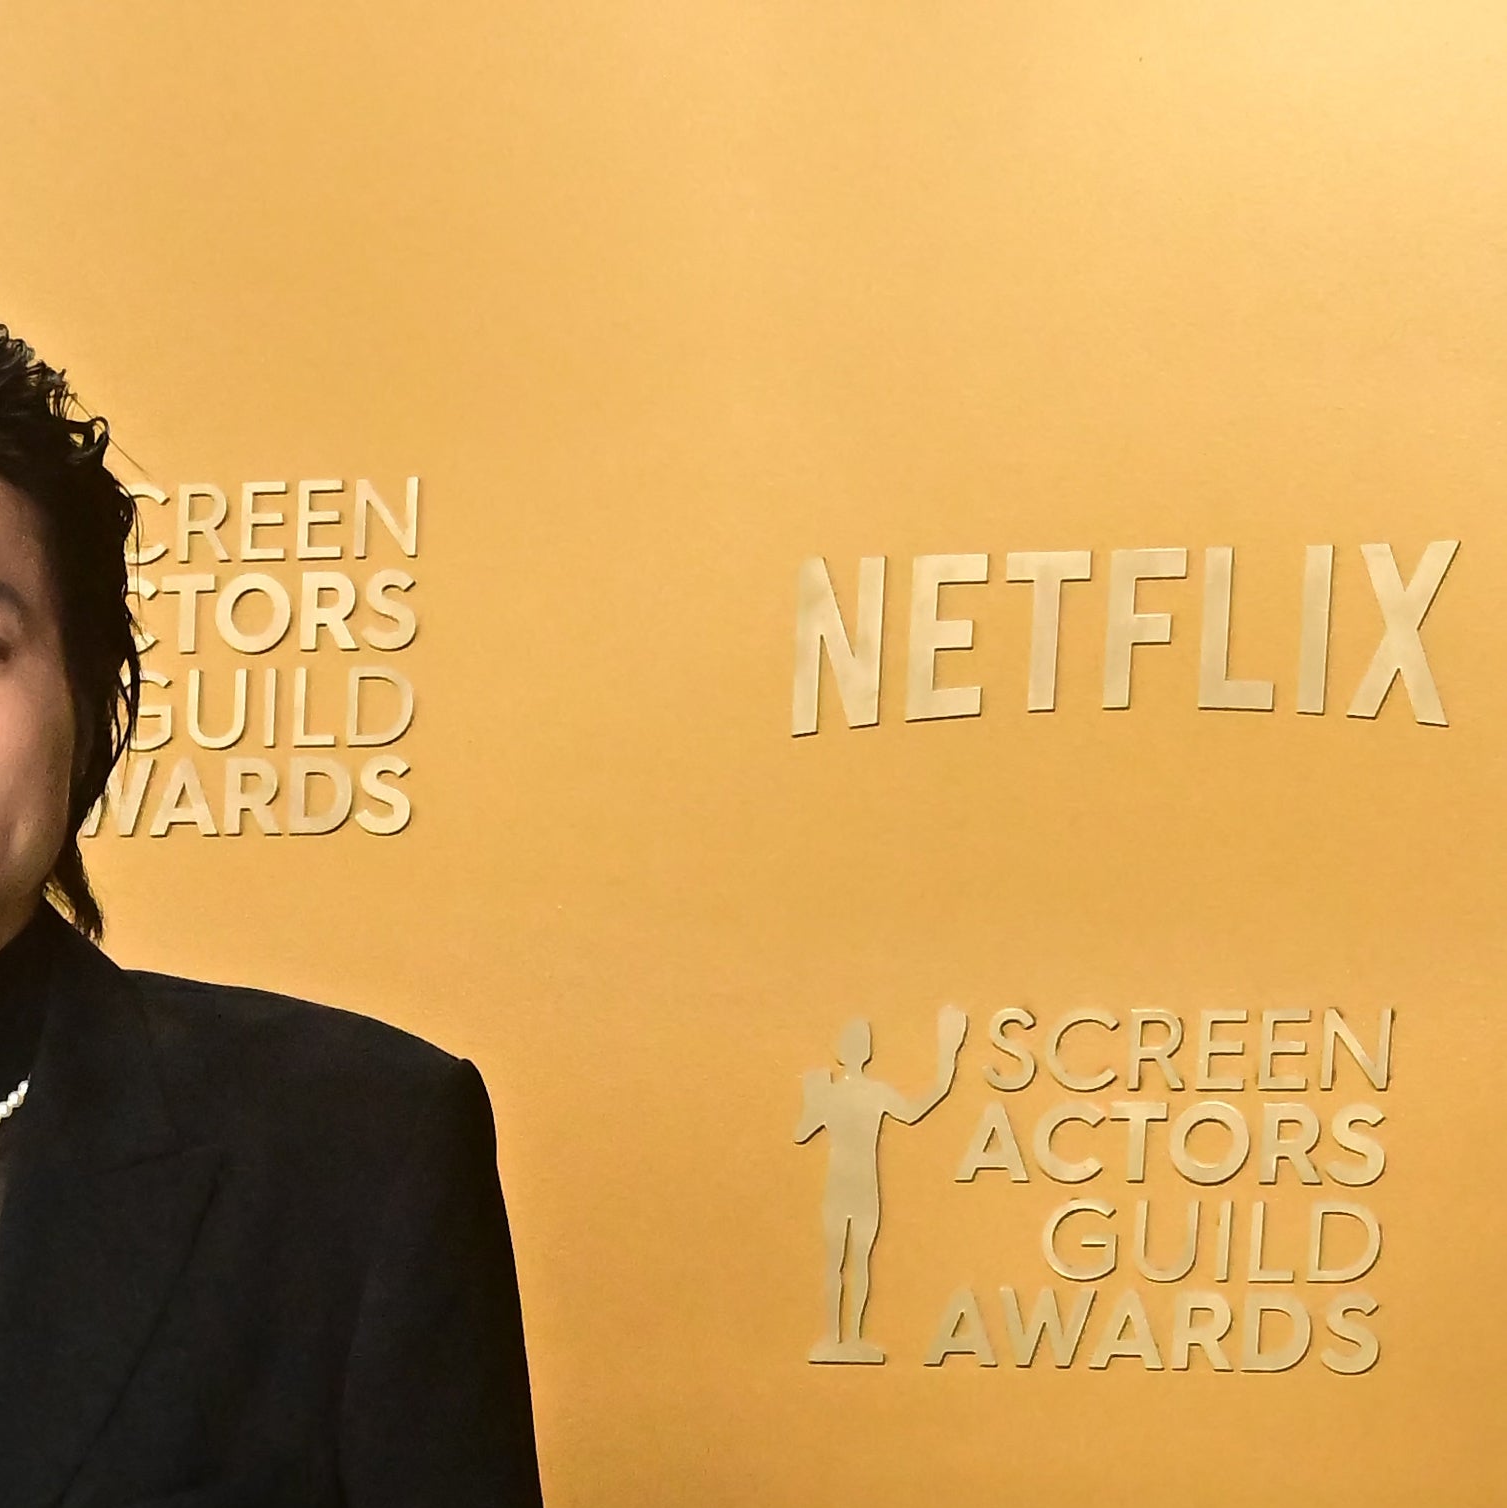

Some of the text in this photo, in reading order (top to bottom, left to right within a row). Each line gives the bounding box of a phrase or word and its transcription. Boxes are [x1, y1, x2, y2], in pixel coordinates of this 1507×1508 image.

[121, 476, 420, 566] CREEN
[791, 539, 1462, 739] NETFLIX
[982, 1005, 1396, 1093] SCREEN
[953, 1100, 1387, 1187] ACTORS
[1041, 1197, 1384, 1284] GUILD
[923, 1287, 1382, 1376] AWARDS
